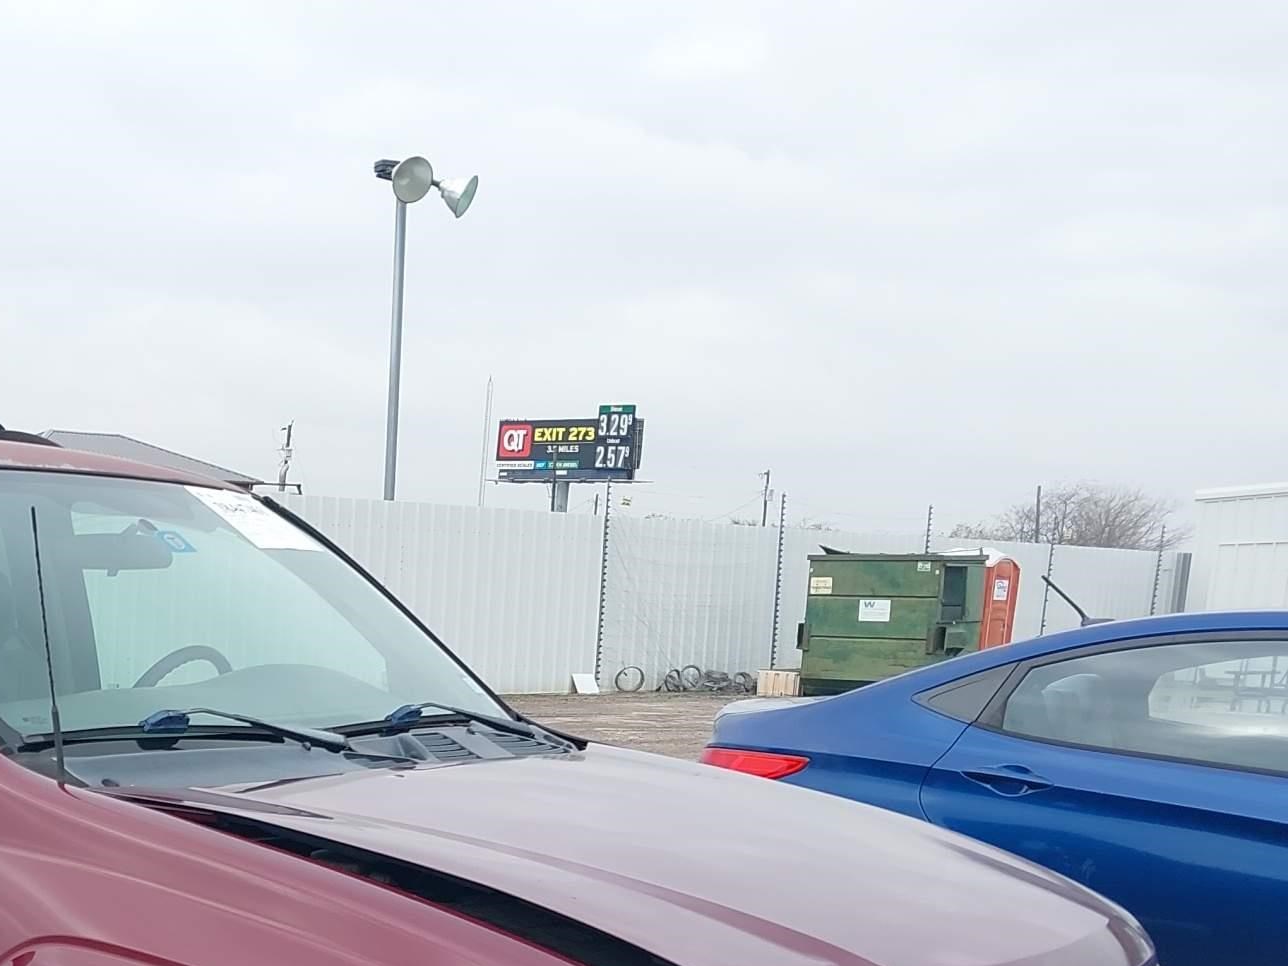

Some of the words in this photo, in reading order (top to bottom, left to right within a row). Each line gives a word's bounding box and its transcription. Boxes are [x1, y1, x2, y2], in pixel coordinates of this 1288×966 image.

[503, 429, 528, 452] QT
[533, 427, 565, 441] EXIT
[568, 427, 595, 440] 273
[558, 445, 579, 453] MILES
